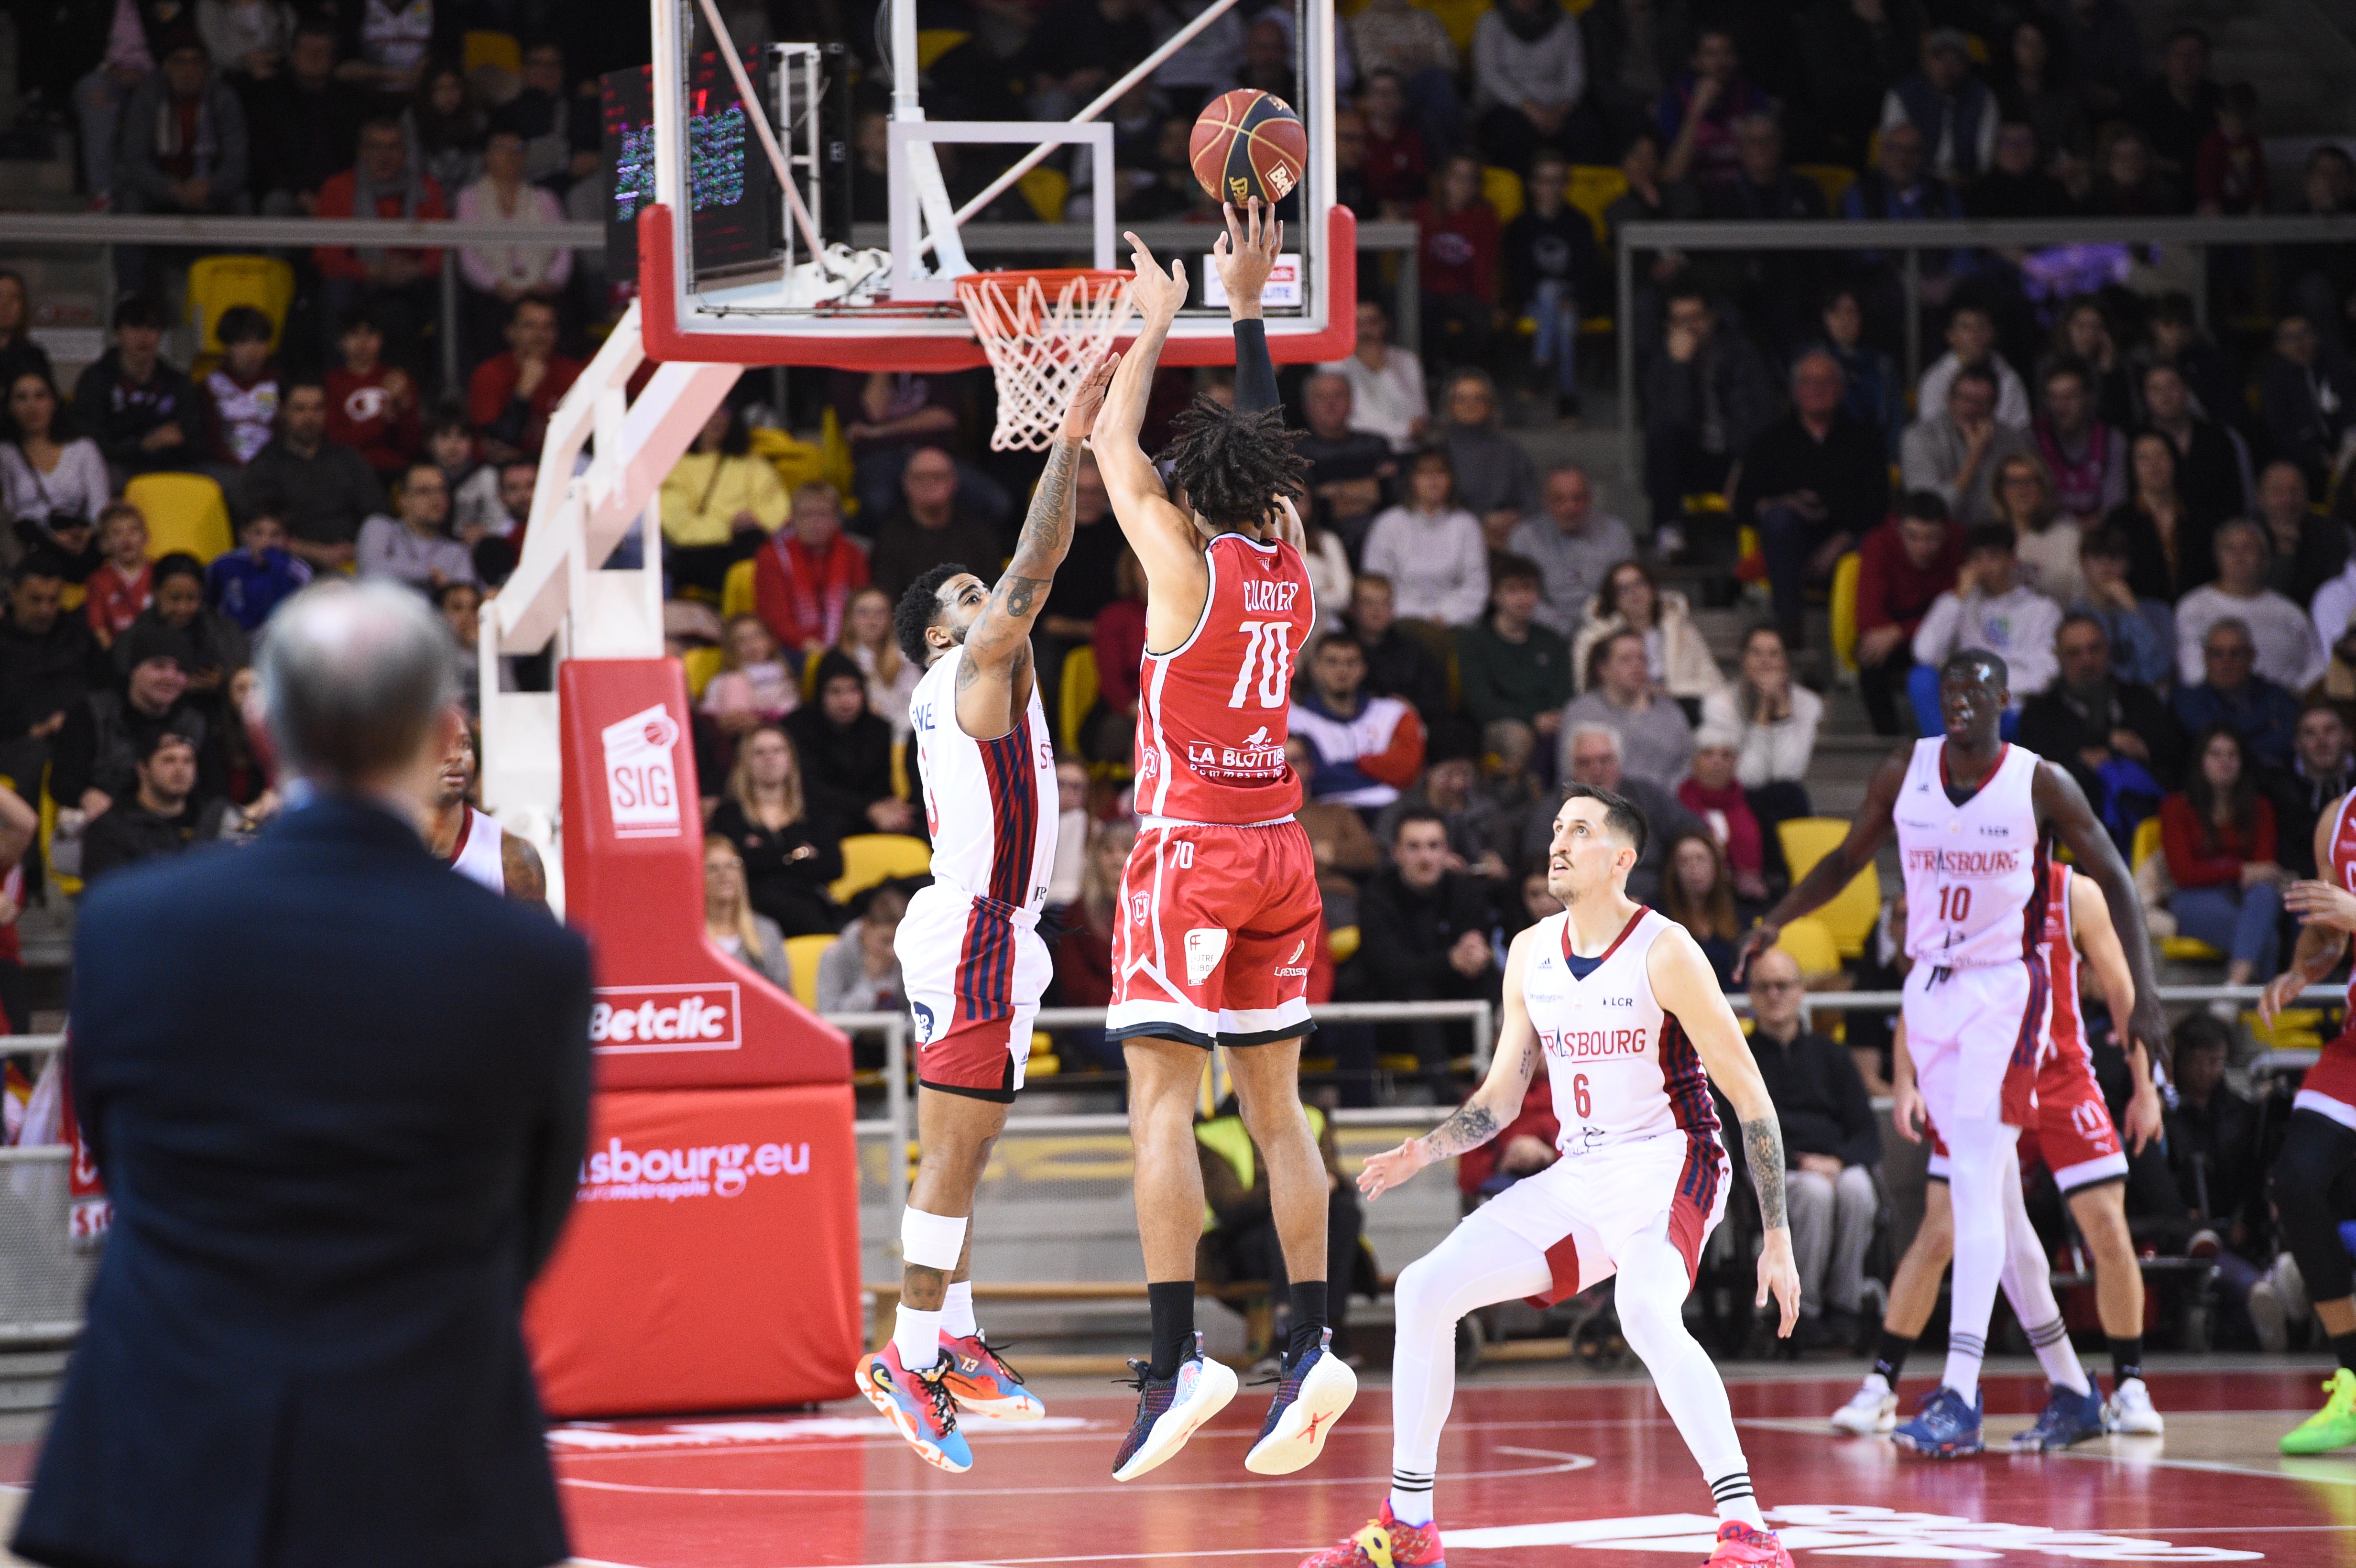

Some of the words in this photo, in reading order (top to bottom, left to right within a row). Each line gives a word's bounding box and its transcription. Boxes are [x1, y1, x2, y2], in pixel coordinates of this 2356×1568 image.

[1243, 580, 1299, 612] CURIER
[1228, 621, 1292, 708] 70
[1189, 745, 1215, 764] LA
[614, 765, 670, 808] SIG
[1169, 840, 1195, 870] 70
[1940, 885, 1972, 922] 10
[589, 994, 727, 1042] Betclic
[1612, 997, 1633, 1007] LCR
[1541, 1025, 1647, 1057] RASBOURG
[1574, 1073, 1591, 1118] 6
[959, 1356, 979, 1373] 13
